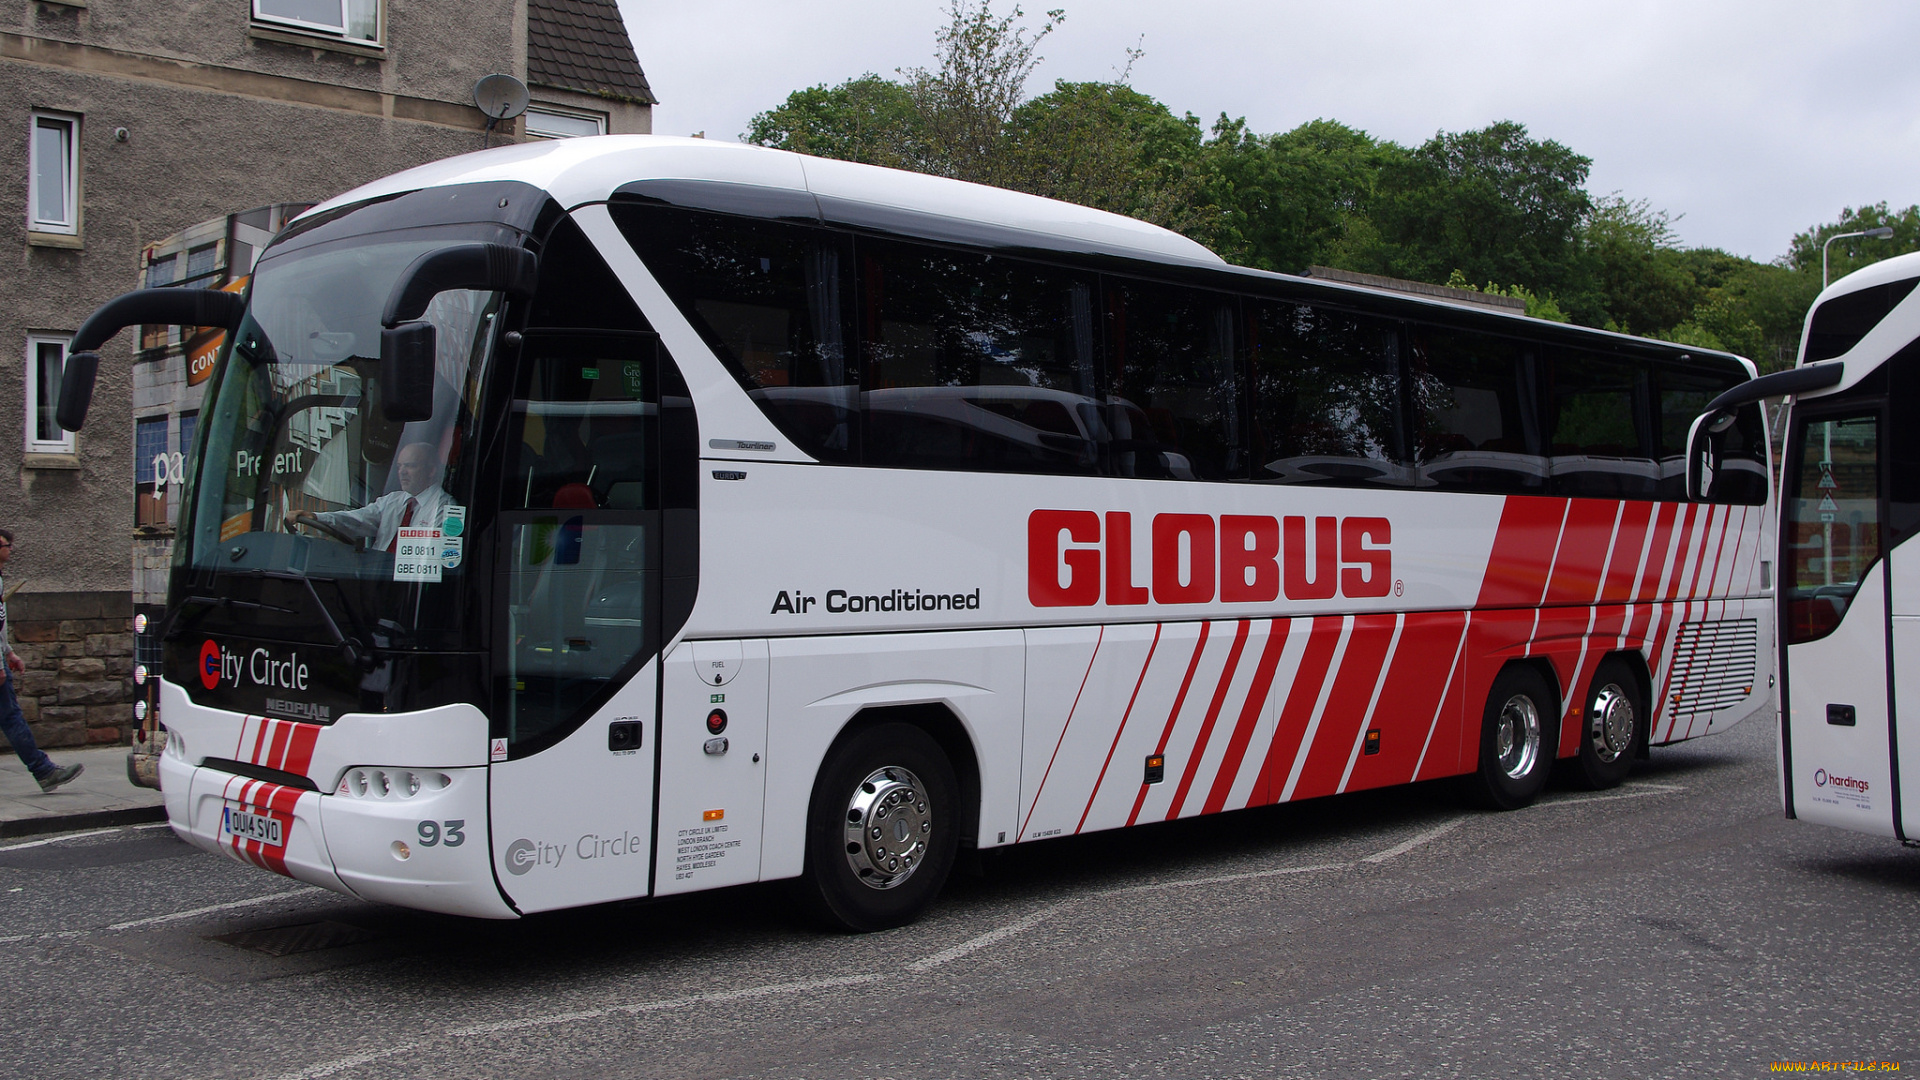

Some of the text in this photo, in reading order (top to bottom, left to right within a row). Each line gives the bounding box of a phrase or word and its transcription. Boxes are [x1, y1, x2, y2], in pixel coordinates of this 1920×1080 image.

[736, 441, 774, 450] Tourliner
[237, 447, 302, 477] Preent
[400, 530, 441, 538] GLOBUS
[401, 545, 413, 555] GB
[414, 546, 435, 556] 0811
[1027, 508, 1392, 607] GLOBUS
[397, 563, 437, 574] GBE 0811
[770, 587, 980, 614] Air Conditioned
[199, 639, 309, 691] City Circle
[266, 697, 330, 722] NEOPLAN
[1829, 773, 1869, 793] hardings
[233, 812, 278, 841] OU14 SVO
[417, 819, 466, 847] 93
[678, 829, 688, 837] CITY
[689, 827, 704, 835] CIRCLE
[711, 825, 728, 833] LIMITED
[677, 835, 714, 846] LONDON BRANCH
[690, 845, 709, 853] LONDON
[709, 843, 724, 851] COACH
[724, 840, 741, 849] CENTRE
[505, 831, 641, 876] City Circle
[676, 855, 692, 863] NORTH
[704, 850, 725, 860] GARDENS
[692, 860, 716, 869] MIDDLESEX
